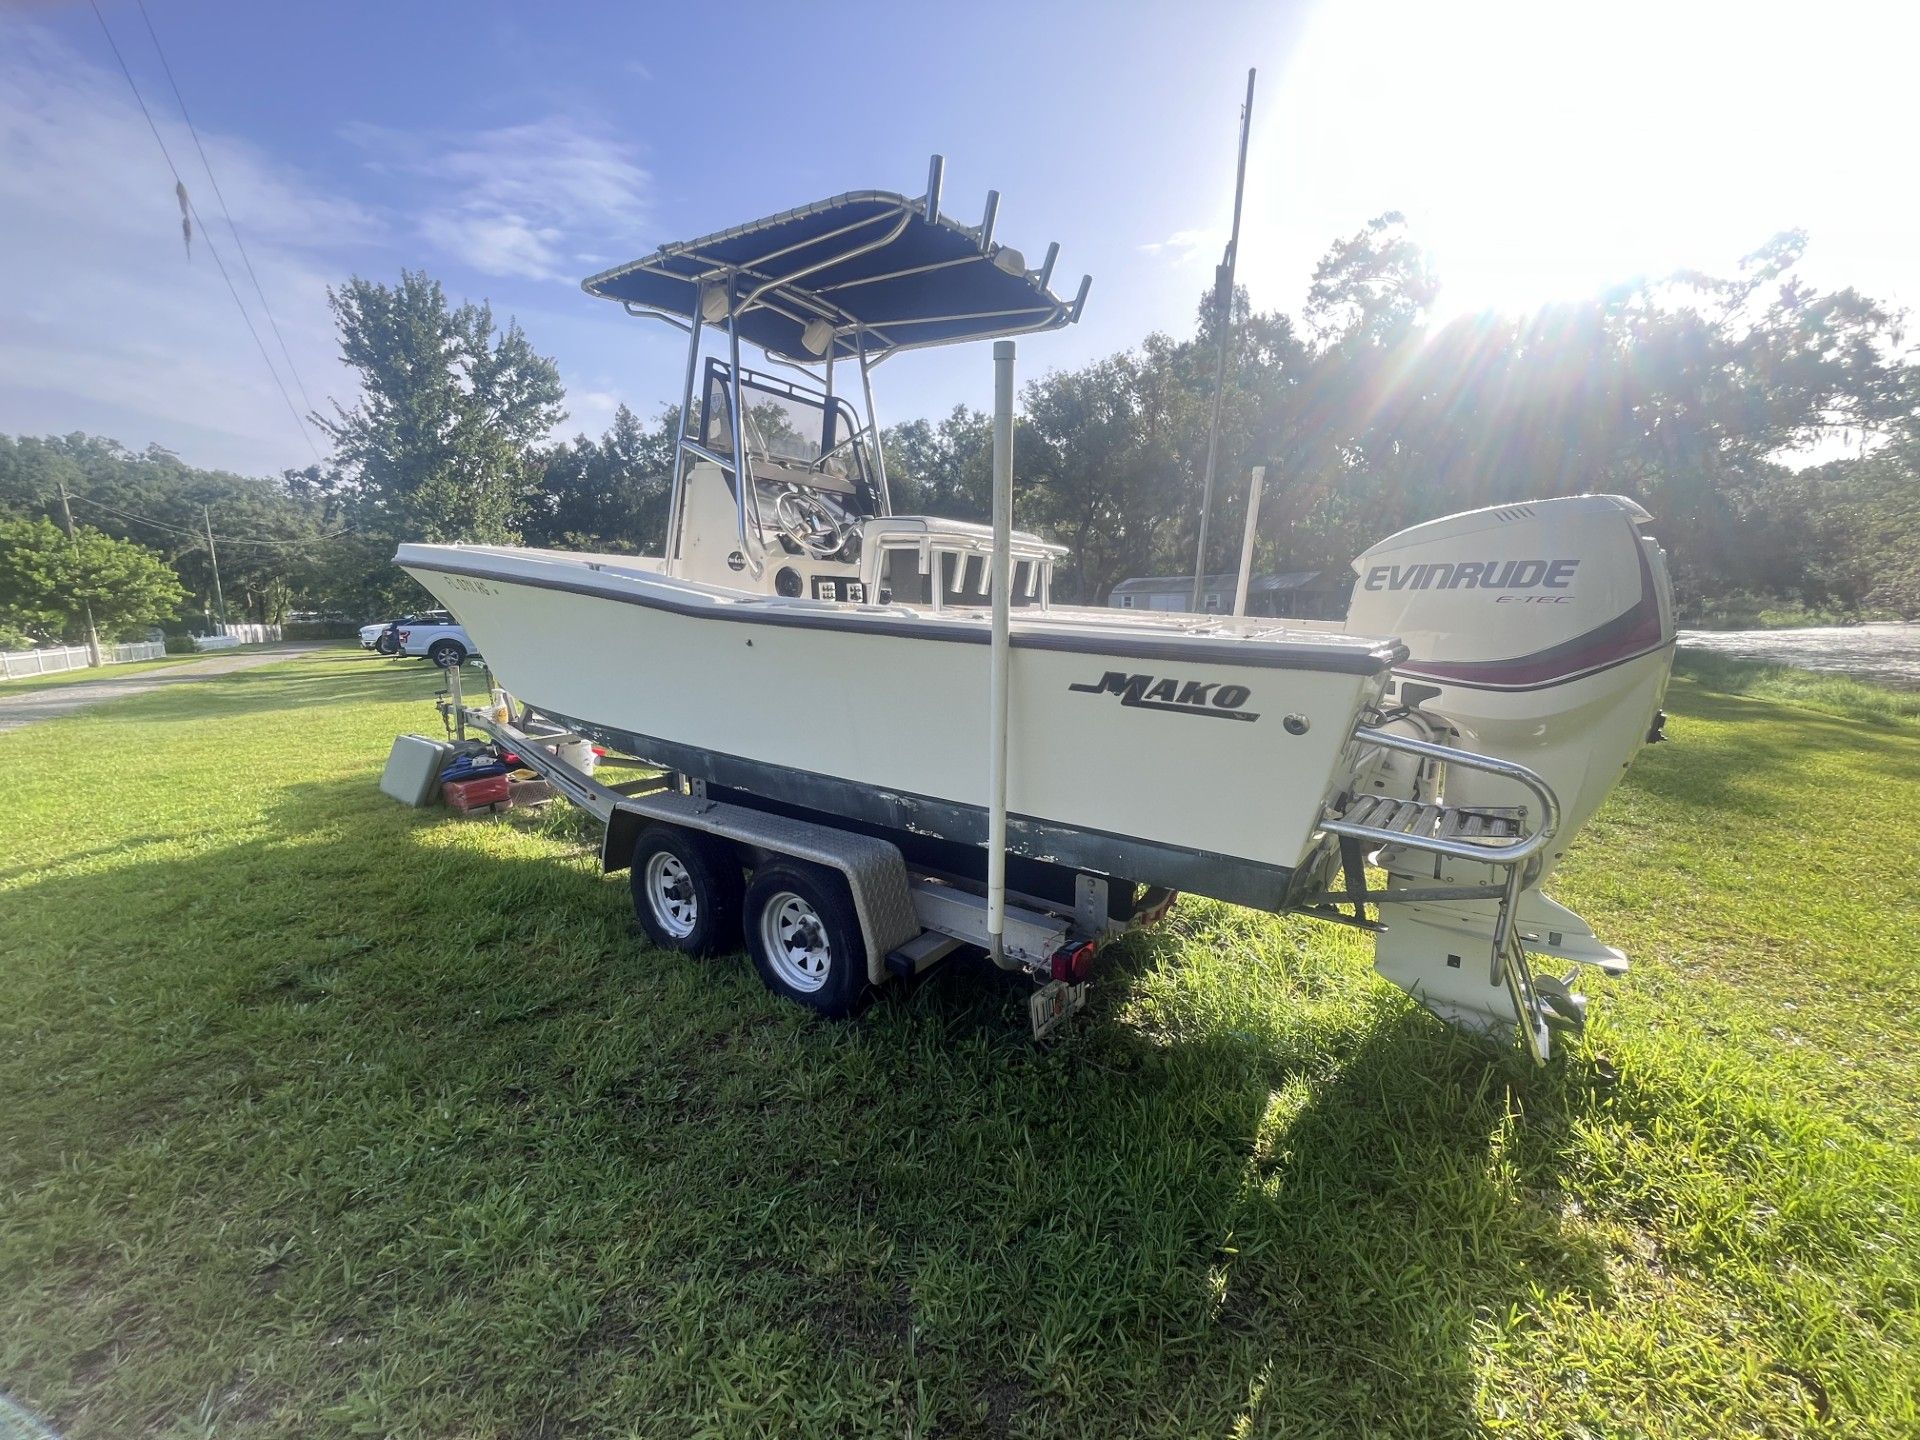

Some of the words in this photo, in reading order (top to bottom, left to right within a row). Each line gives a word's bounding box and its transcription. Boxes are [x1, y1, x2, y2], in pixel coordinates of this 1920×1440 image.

[1364, 560, 1580, 591] EVINRUDE
[1495, 595, 1576, 604] E-TEC
[1069, 671, 1260, 722] MAKO
